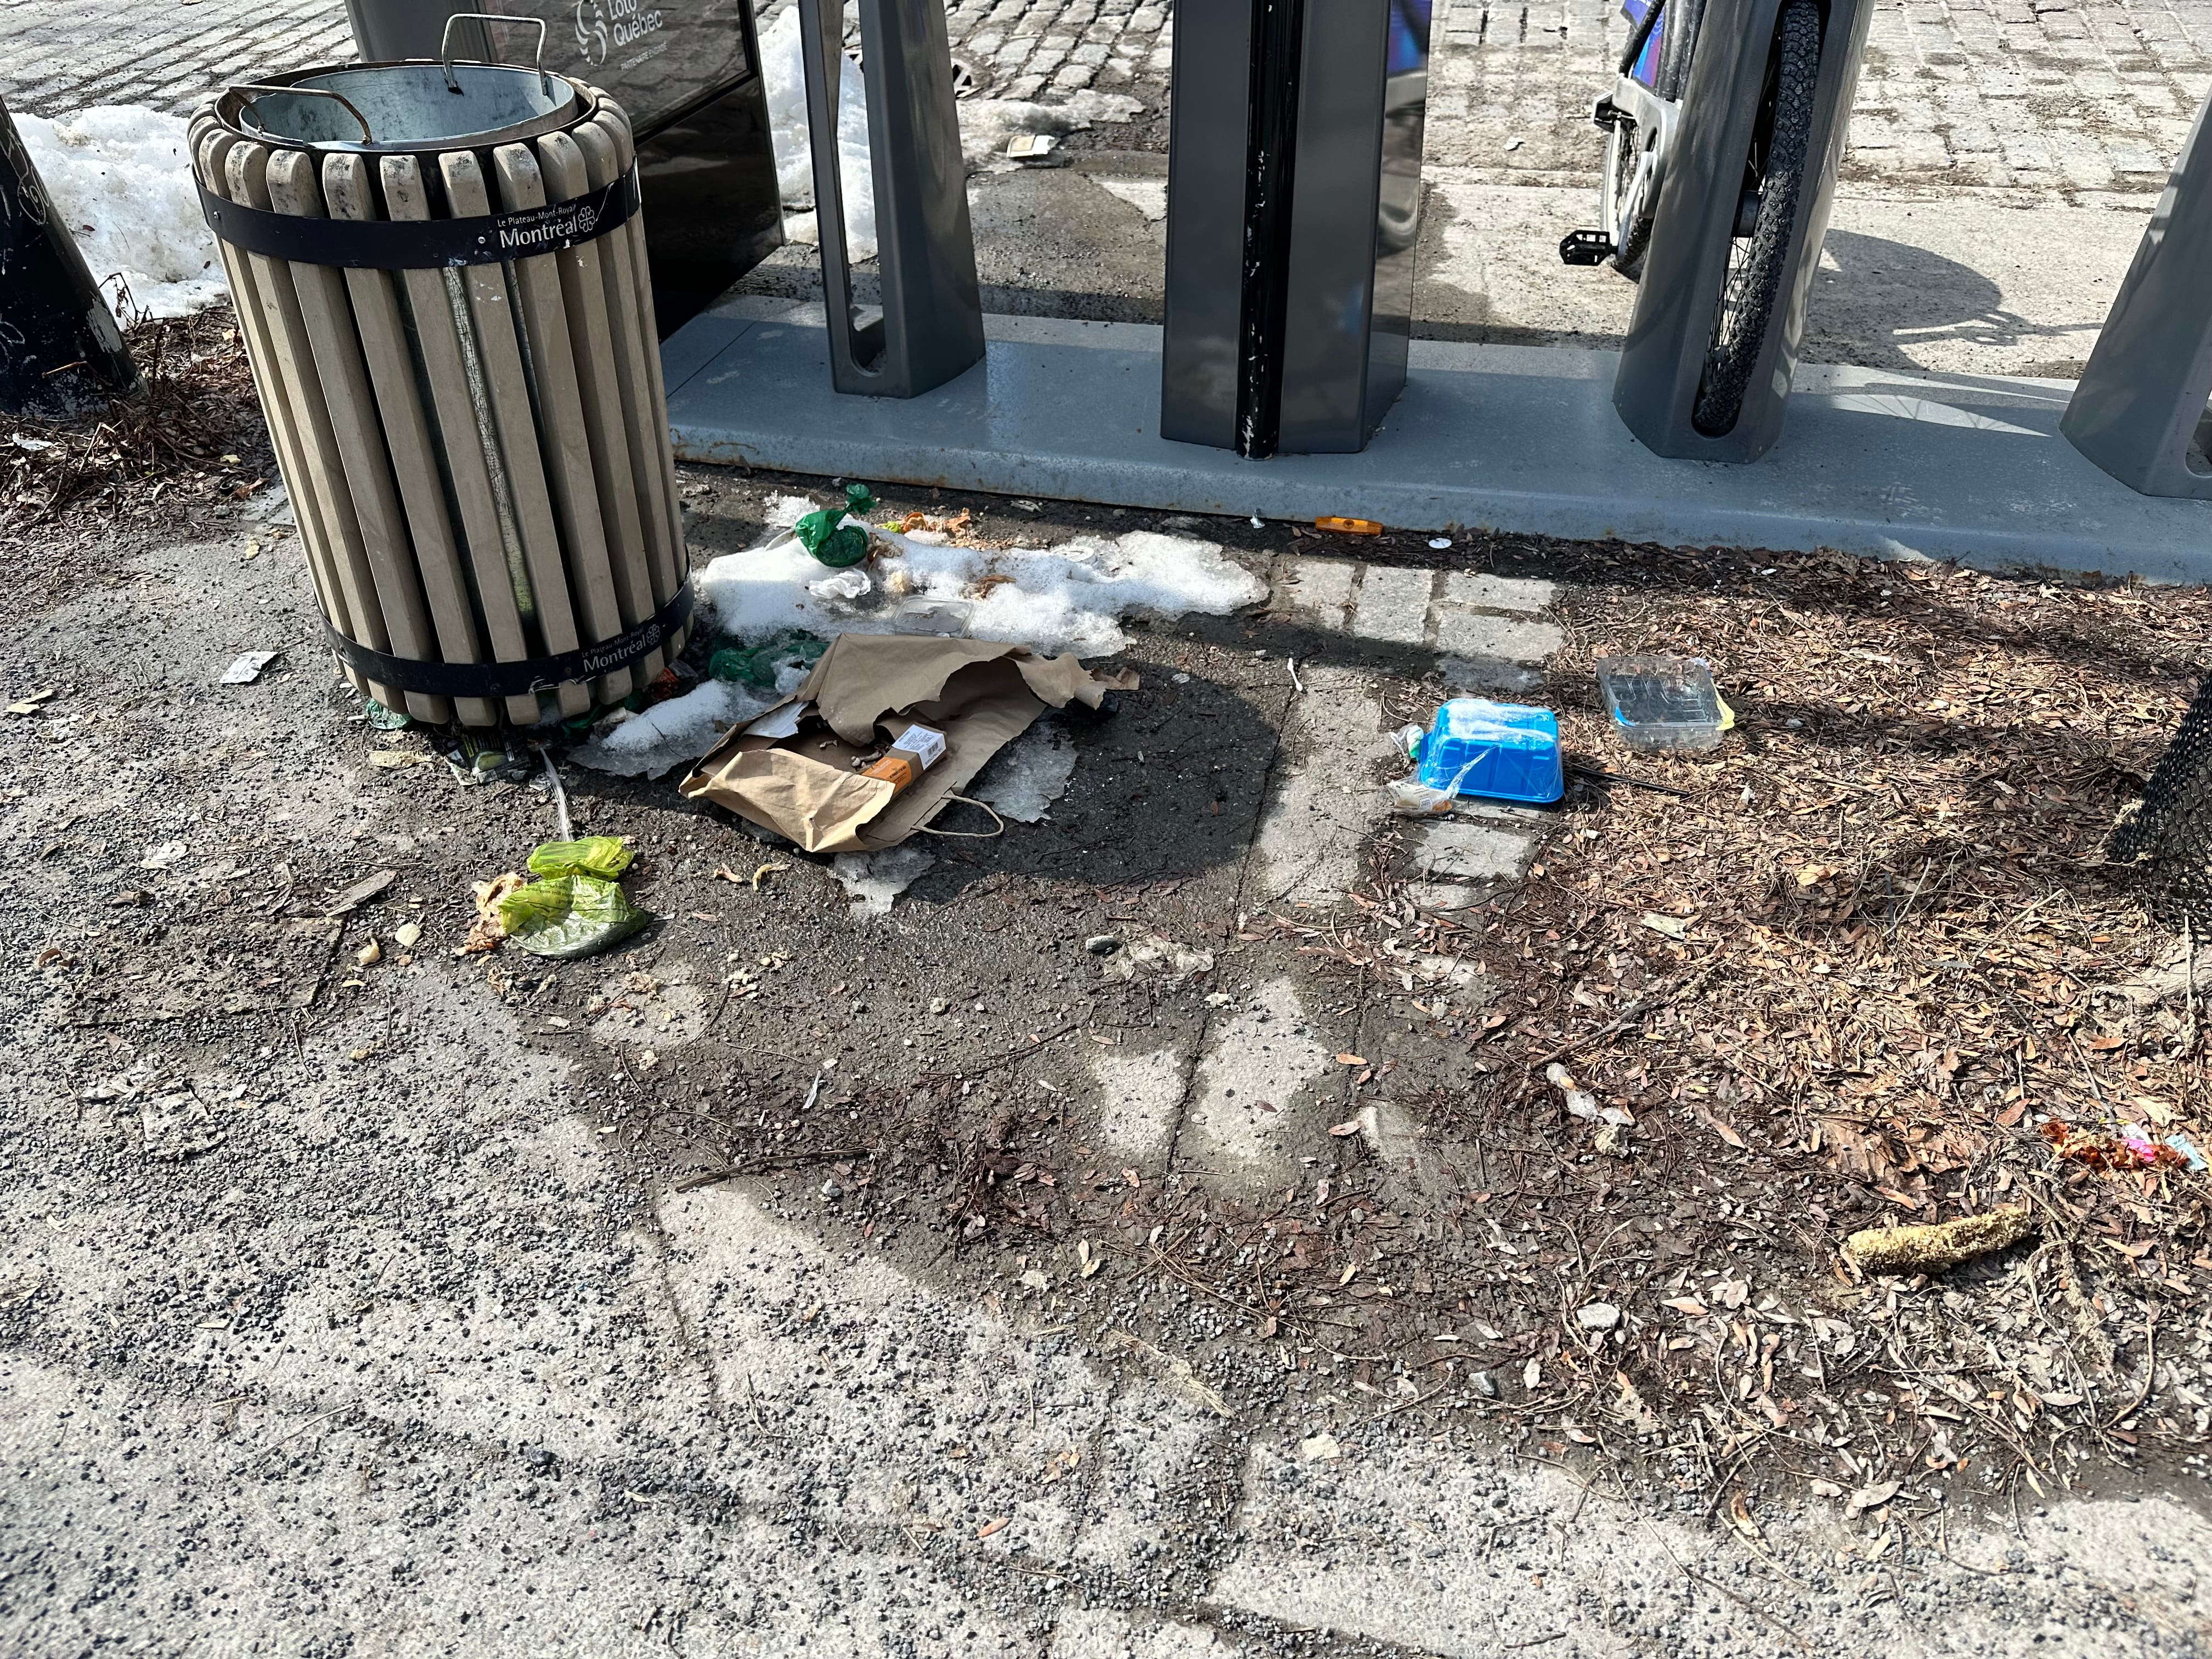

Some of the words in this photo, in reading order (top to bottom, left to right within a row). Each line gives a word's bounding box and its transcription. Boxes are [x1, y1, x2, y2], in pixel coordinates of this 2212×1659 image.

[607, 0, 637, 20] Loto
[613, 10, 663, 47] Québec
[498, 219, 506, 227] Le
[508, 205, 576, 225] Plateau-Mont-Royal
[499, 216, 578, 248] Montréal
[583, 634, 646, 673] Montréal
[590, 627, 644, 655] Plateau-Mont-Royal
